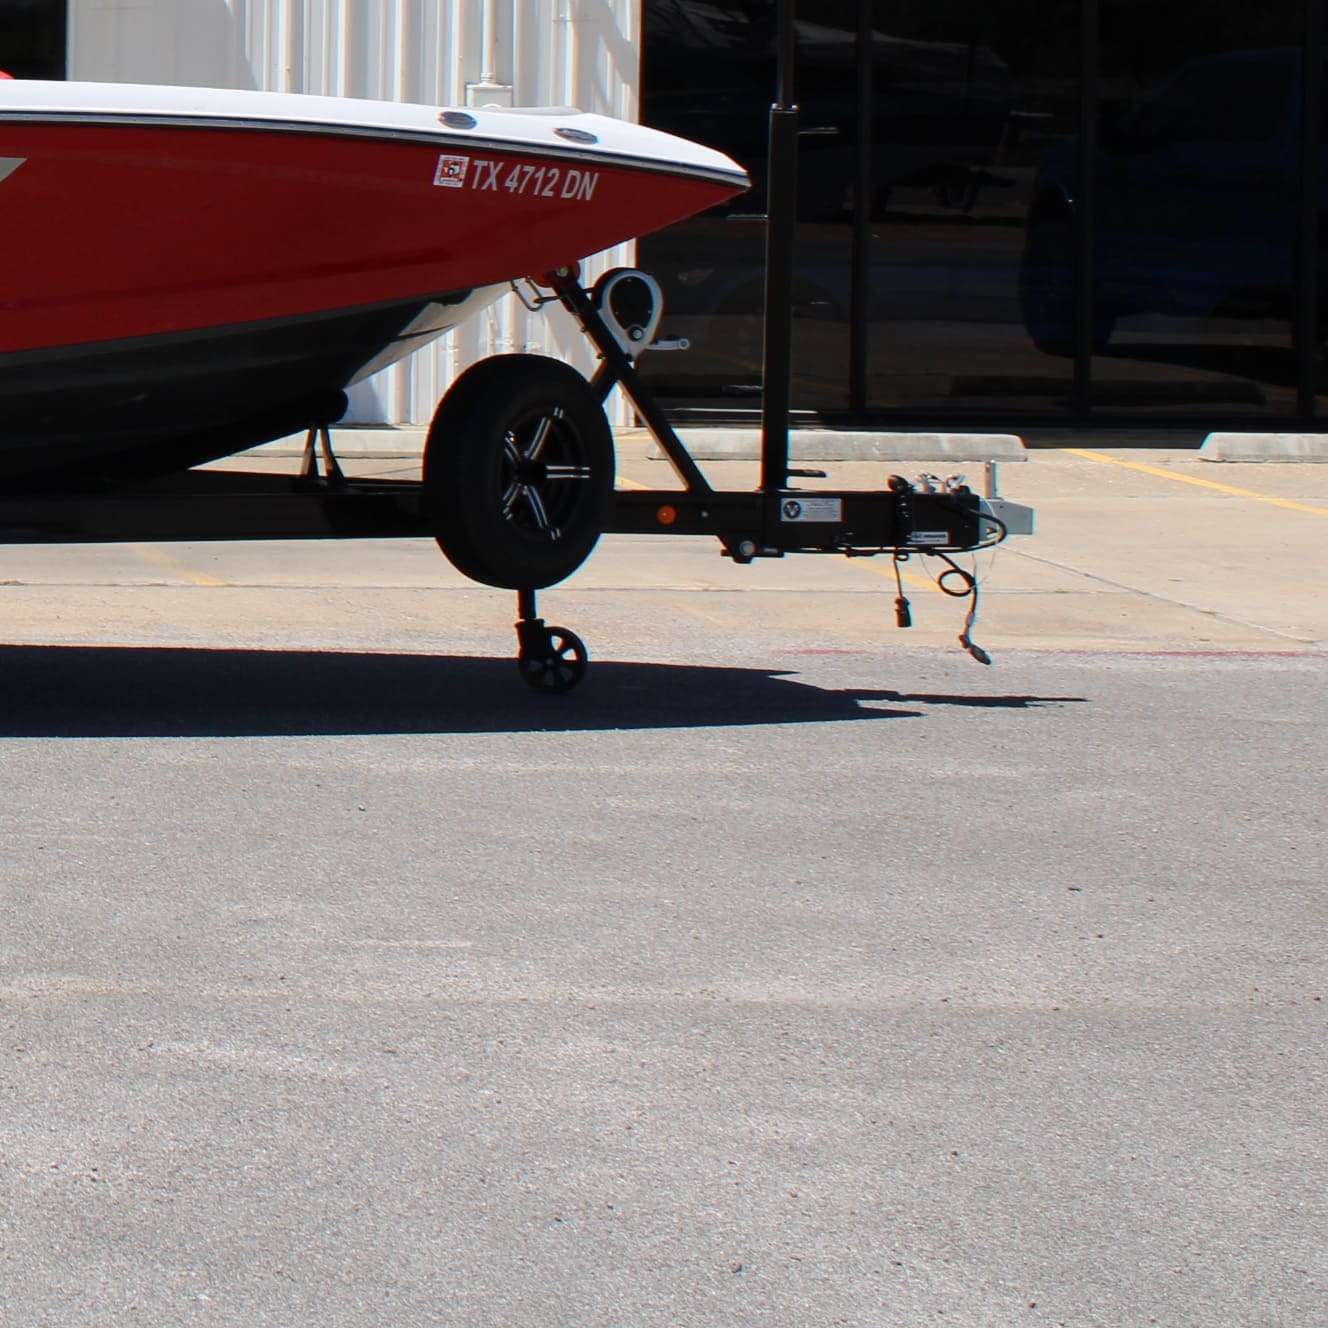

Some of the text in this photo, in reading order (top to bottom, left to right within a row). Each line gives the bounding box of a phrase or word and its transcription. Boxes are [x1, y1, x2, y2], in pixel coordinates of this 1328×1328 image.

[472, 159, 504, 191] TX
[504, 163, 561, 197] 4712
[561, 169, 599, 201] DN
